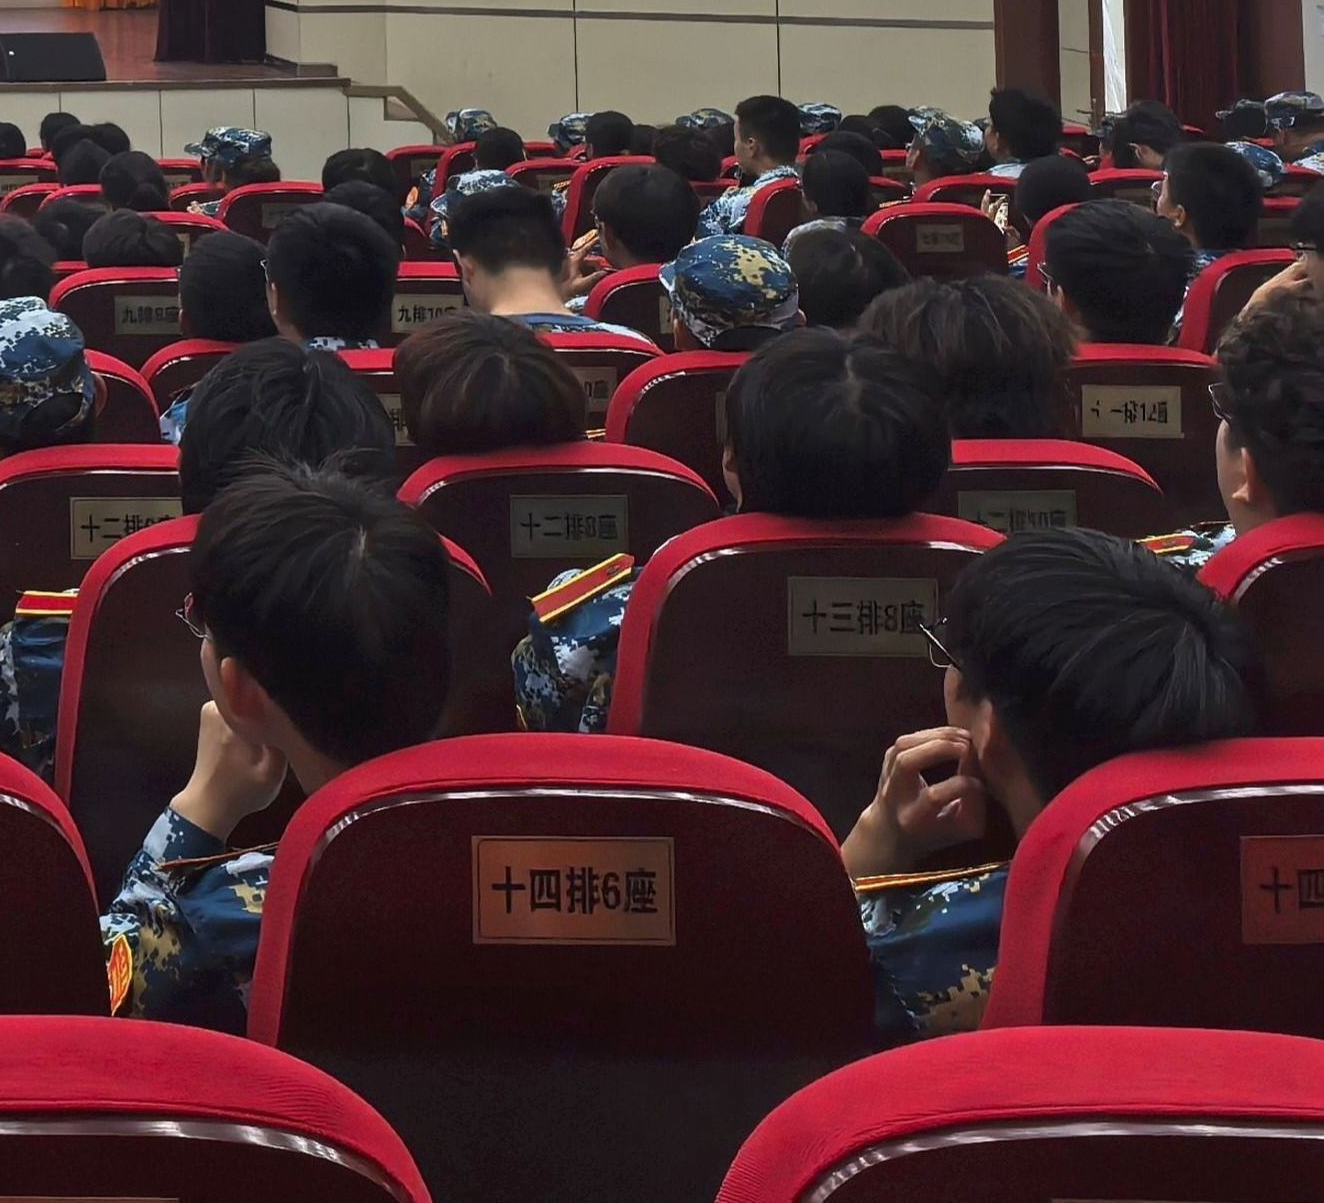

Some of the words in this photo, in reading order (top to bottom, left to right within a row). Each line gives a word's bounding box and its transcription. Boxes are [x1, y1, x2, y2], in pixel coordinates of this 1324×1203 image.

[801, 599, 927, 636] 十三排8座
[490, 865, 659, 916] 十四排6座
